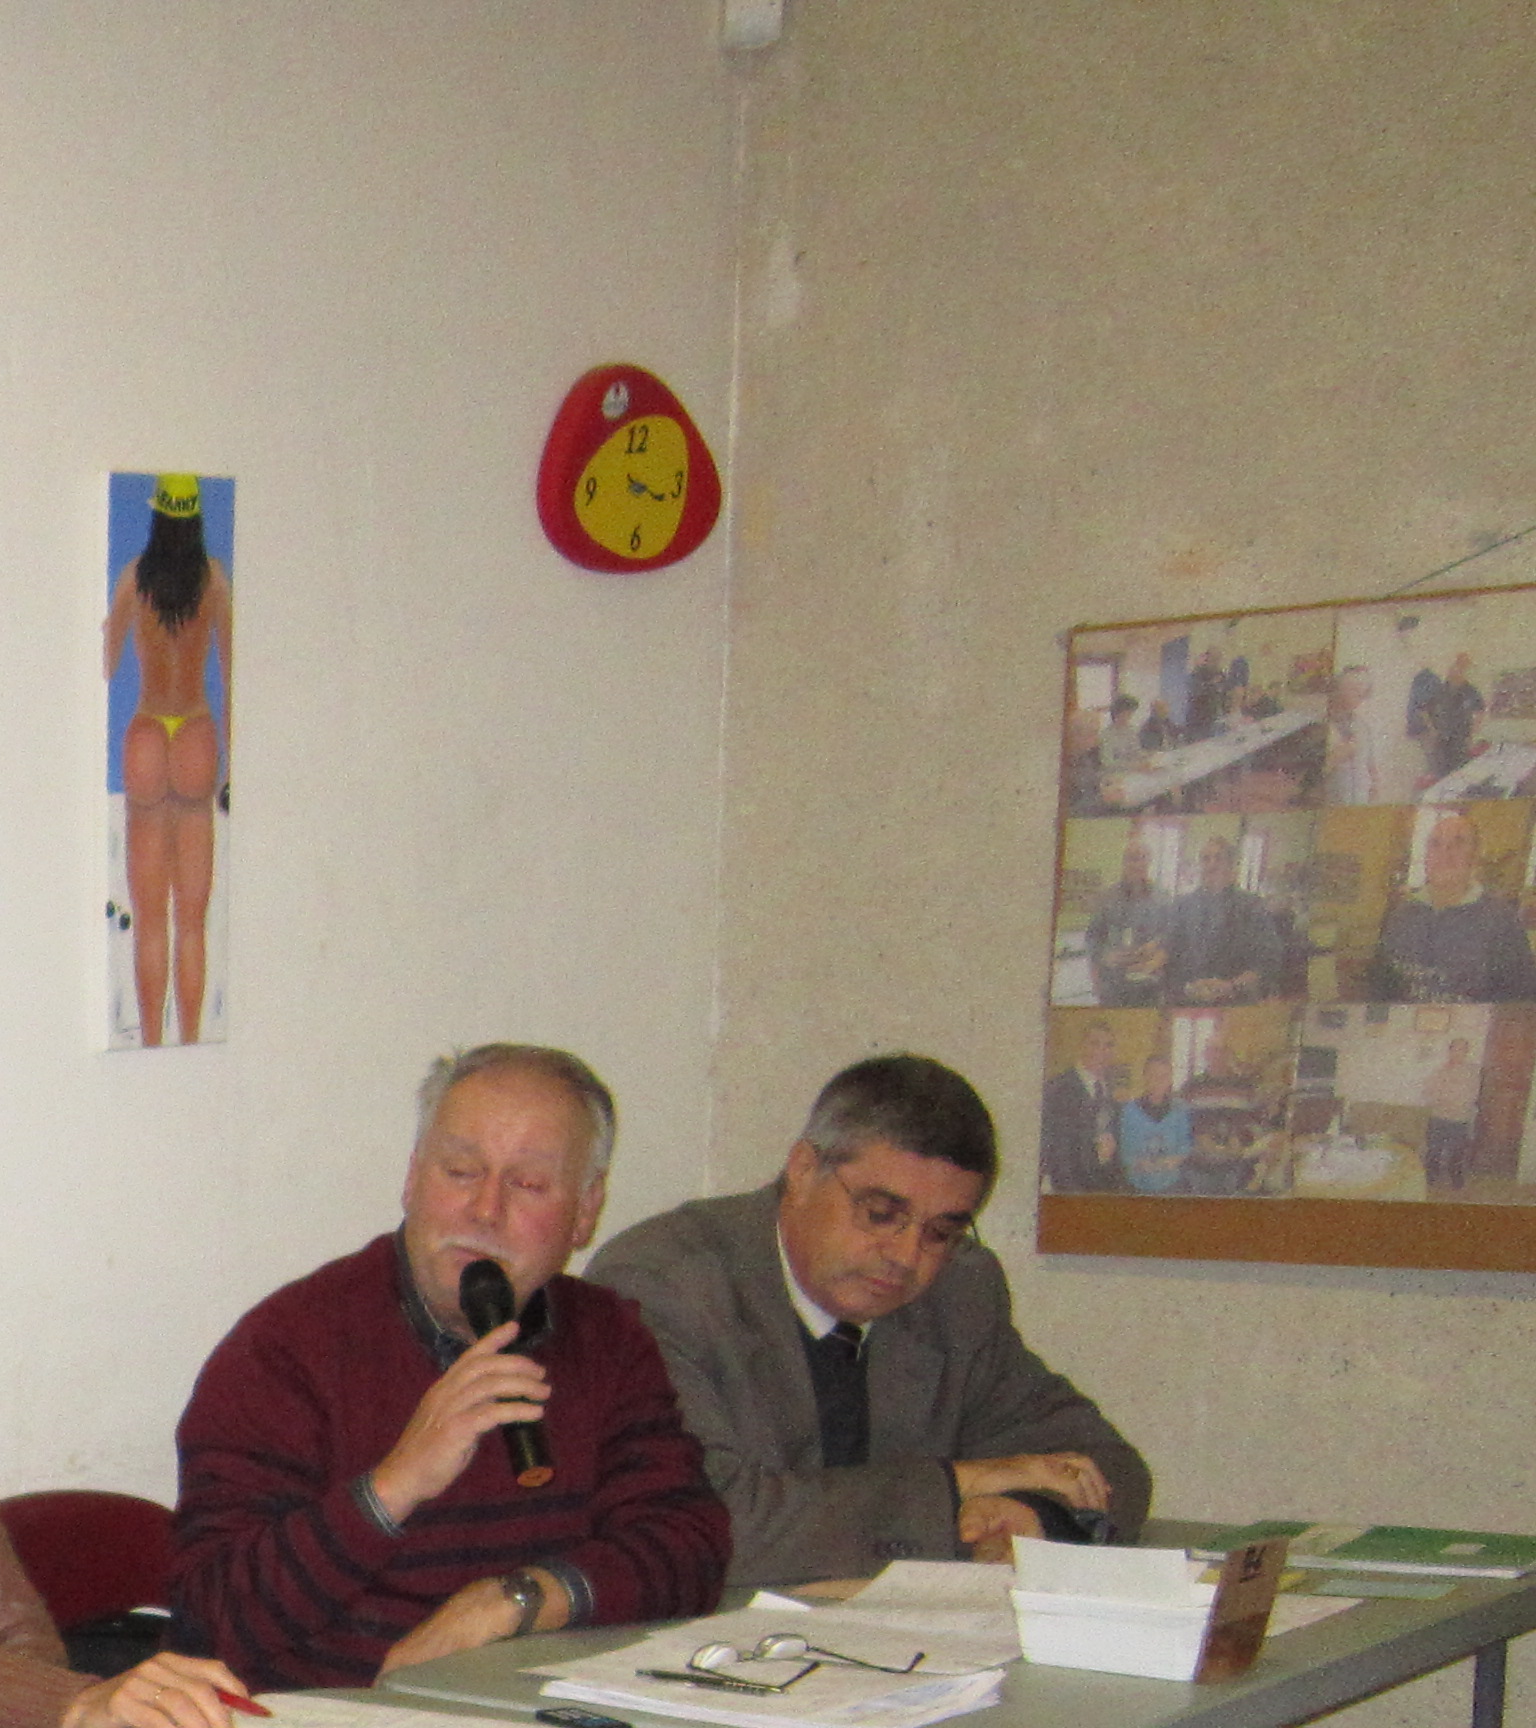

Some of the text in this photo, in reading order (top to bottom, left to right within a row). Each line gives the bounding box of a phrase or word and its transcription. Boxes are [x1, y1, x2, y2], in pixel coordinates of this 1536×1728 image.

[625, 424, 649, 454] 12
[585, 477, 598, 507] 9
[670, 470, 684, 499] 3
[630, 524, 642, 552] 6
